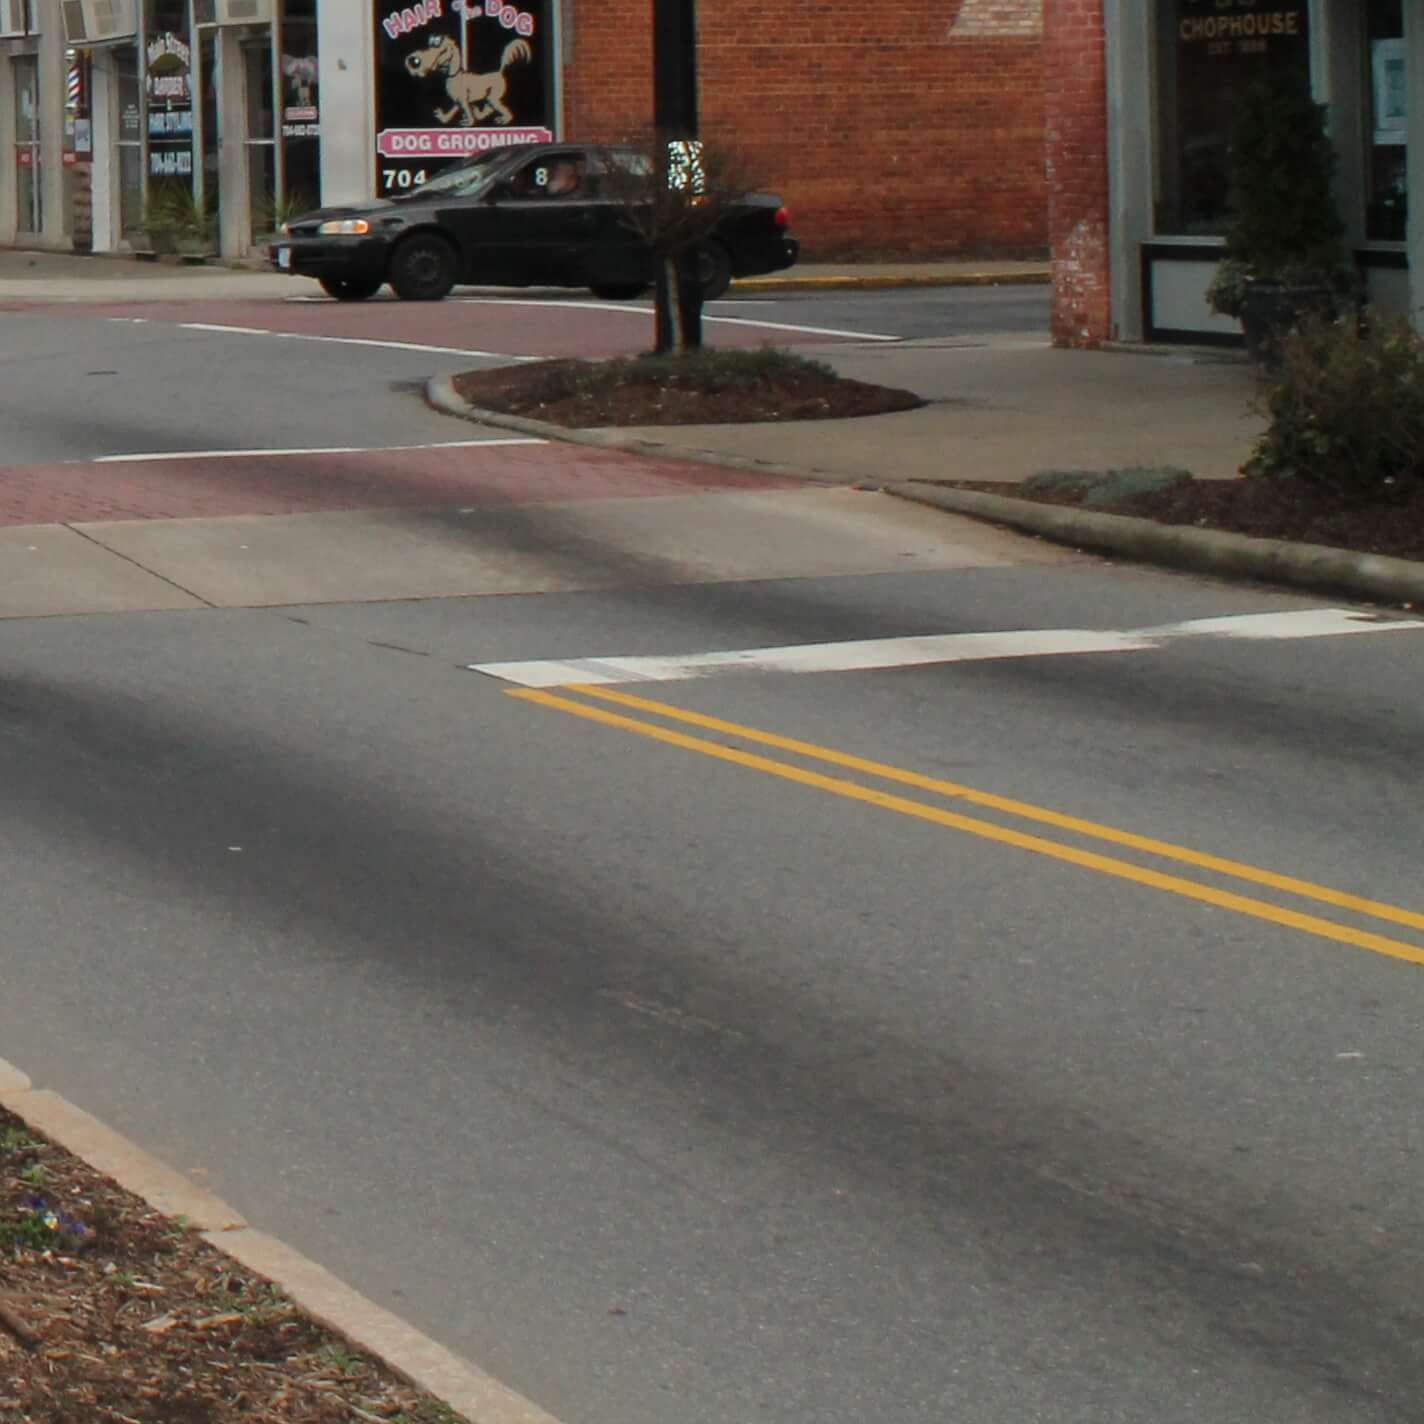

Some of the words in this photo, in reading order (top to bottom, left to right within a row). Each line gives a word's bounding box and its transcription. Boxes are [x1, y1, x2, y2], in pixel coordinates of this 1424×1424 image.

[1180, 11, 1296, 39] CHOPHOUSE
[391, 135, 433, 150] DOG
[437, 133, 540, 150] GROOMING
[382, 170, 426, 188] 704
